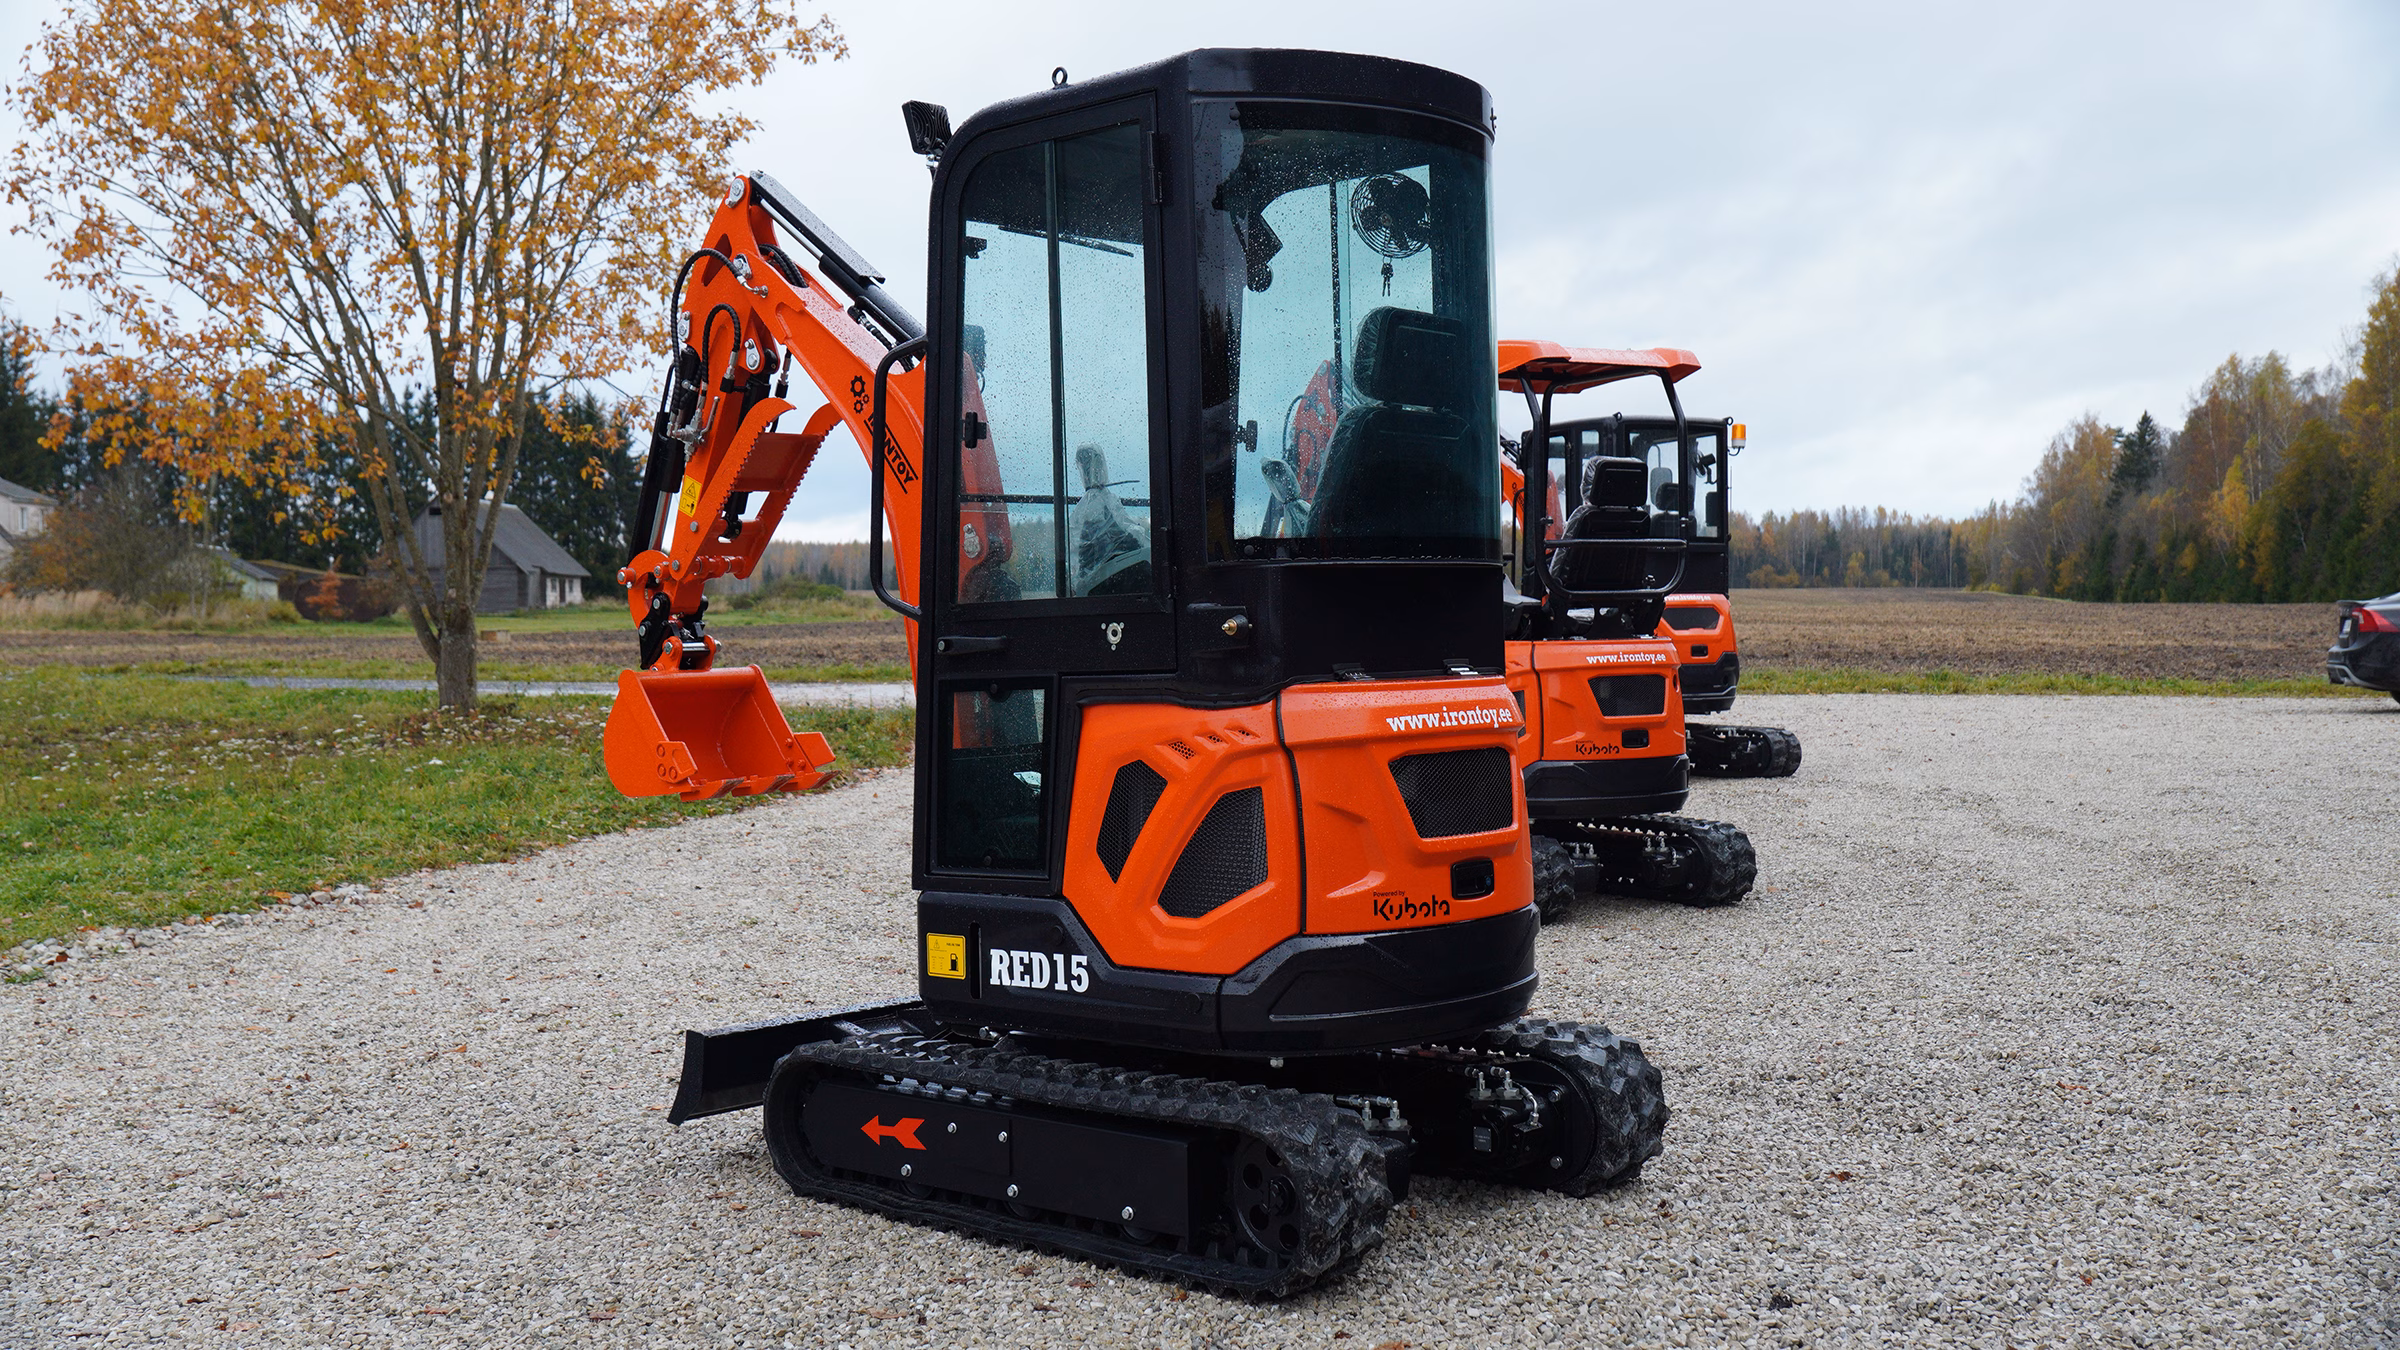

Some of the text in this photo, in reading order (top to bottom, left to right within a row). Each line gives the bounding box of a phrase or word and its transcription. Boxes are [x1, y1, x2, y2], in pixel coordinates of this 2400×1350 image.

[867, 412, 915, 484] INTOY
[1586, 652, 1667, 664] www.irontoy.ee
[1385, 706, 1513, 732] www.irontoy.ee
[1575, 743, 1620, 756] Kubota
[1373, 890, 1398, 898] Powered
[1373, 894, 1451, 921] Kubota
[989, 948, 1090, 993] RED15
